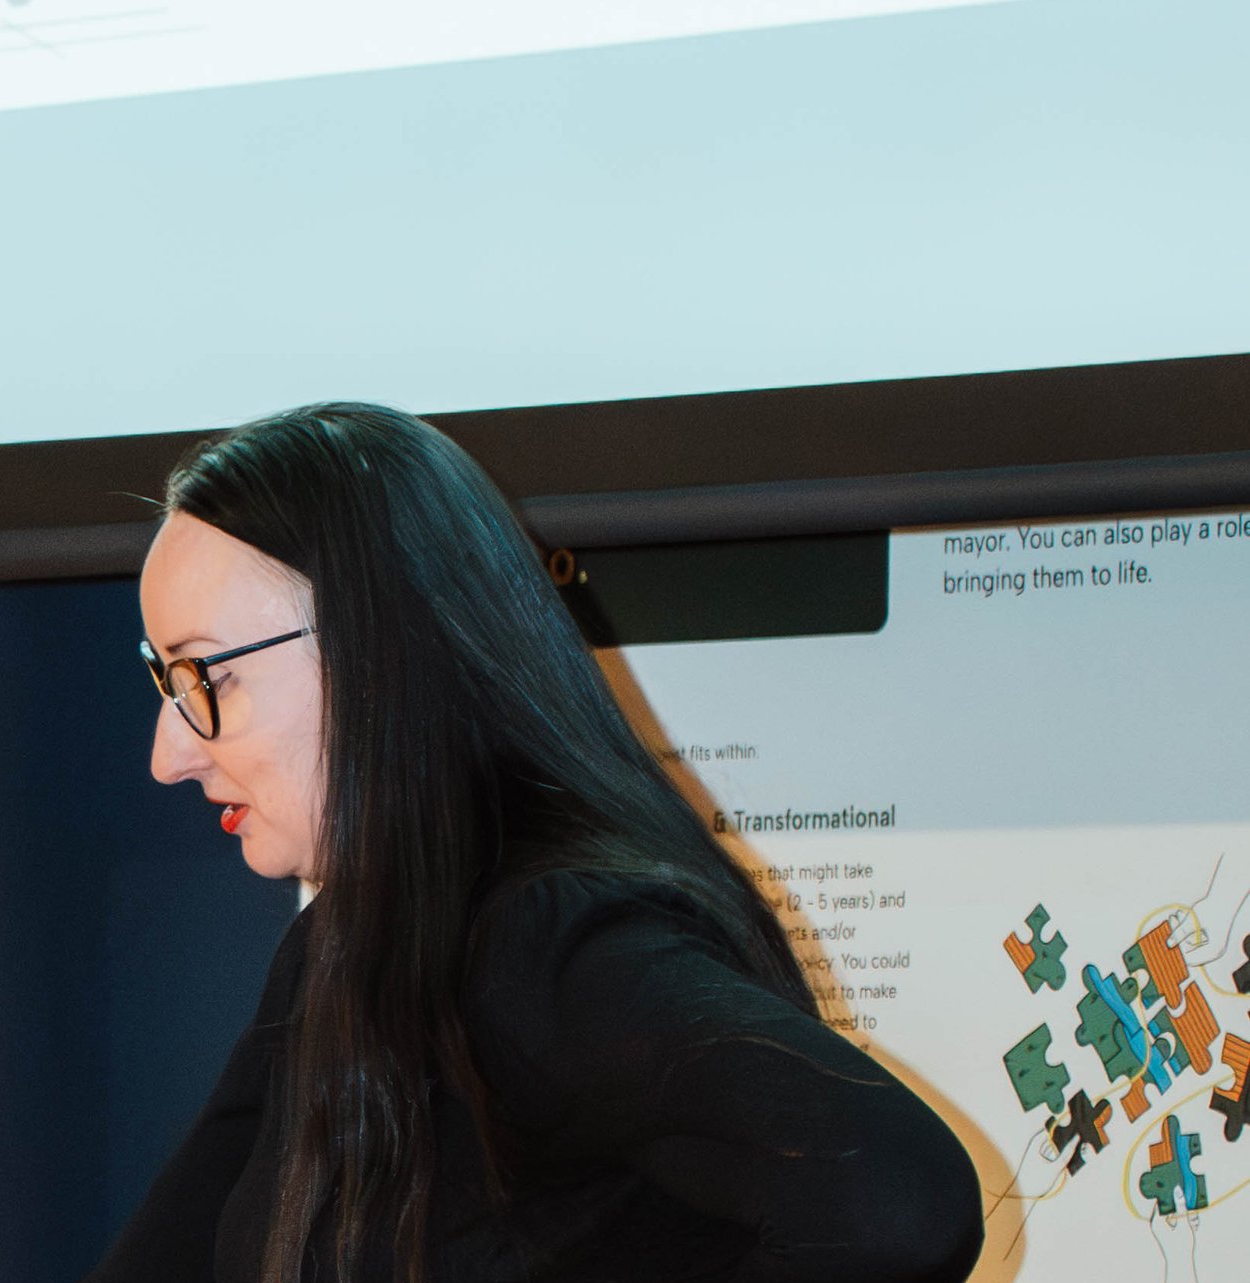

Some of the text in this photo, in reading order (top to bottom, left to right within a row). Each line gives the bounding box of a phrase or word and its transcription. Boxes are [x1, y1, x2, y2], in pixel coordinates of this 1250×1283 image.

[944, 533, 1010, 558] mayor.
[1017, 525, 1055, 550] You
[1061, 526, 1097, 548] can
[1104, 519, 1143, 545] also
[1151, 518, 1192, 548] play
[1199, 521, 1209, 539] a
[943, 559, 1152, 598] bringing them to life.
[690, 745, 711, 761] fits
[733, 803, 896, 833] Transformational
[767, 863, 795, 881] that
[799, 863, 839, 884] might
[844, 863, 874, 879] take
[787, 892, 802, 913] (2
[818, 892, 829, 910] 5
[832, 890, 875, 914] years)
[879, 890, 907, 909] and
[812, 921, 856, 941] and/or
[841, 952, 867, 969] You
[871, 949, 910, 969] could
[840, 984, 854, 1000] to
[859, 982, 897, 999] make
[862, 1014, 878, 1030] to
